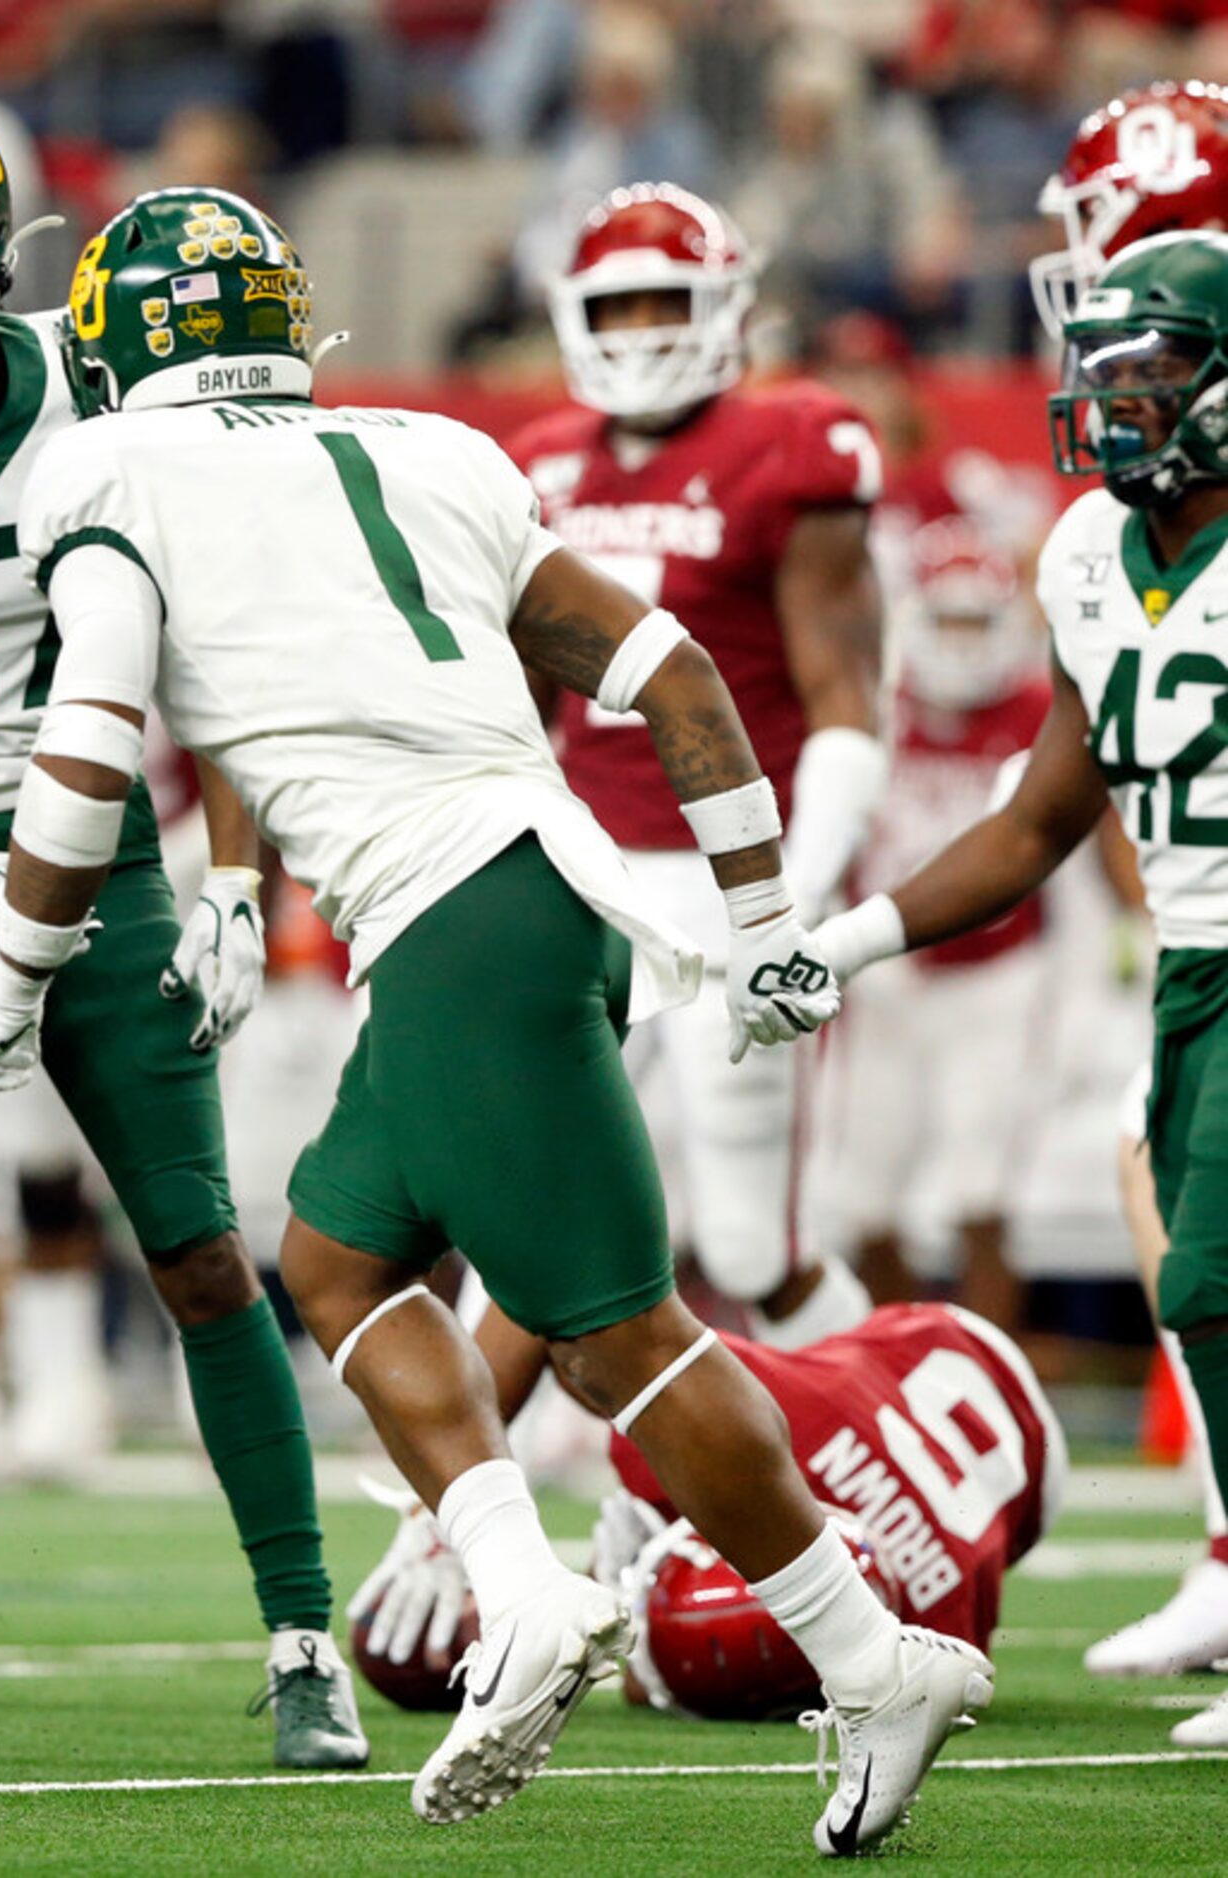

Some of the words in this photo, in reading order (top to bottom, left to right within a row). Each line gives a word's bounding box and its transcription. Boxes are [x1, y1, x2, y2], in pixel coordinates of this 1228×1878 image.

[69, 235, 111, 341] BU
[197, 366, 272, 394] BAYLOR
[314, 431, 465, 662] 1
[1088, 647, 1228, 848] 42
[808, 1426, 962, 1614] BROWN
